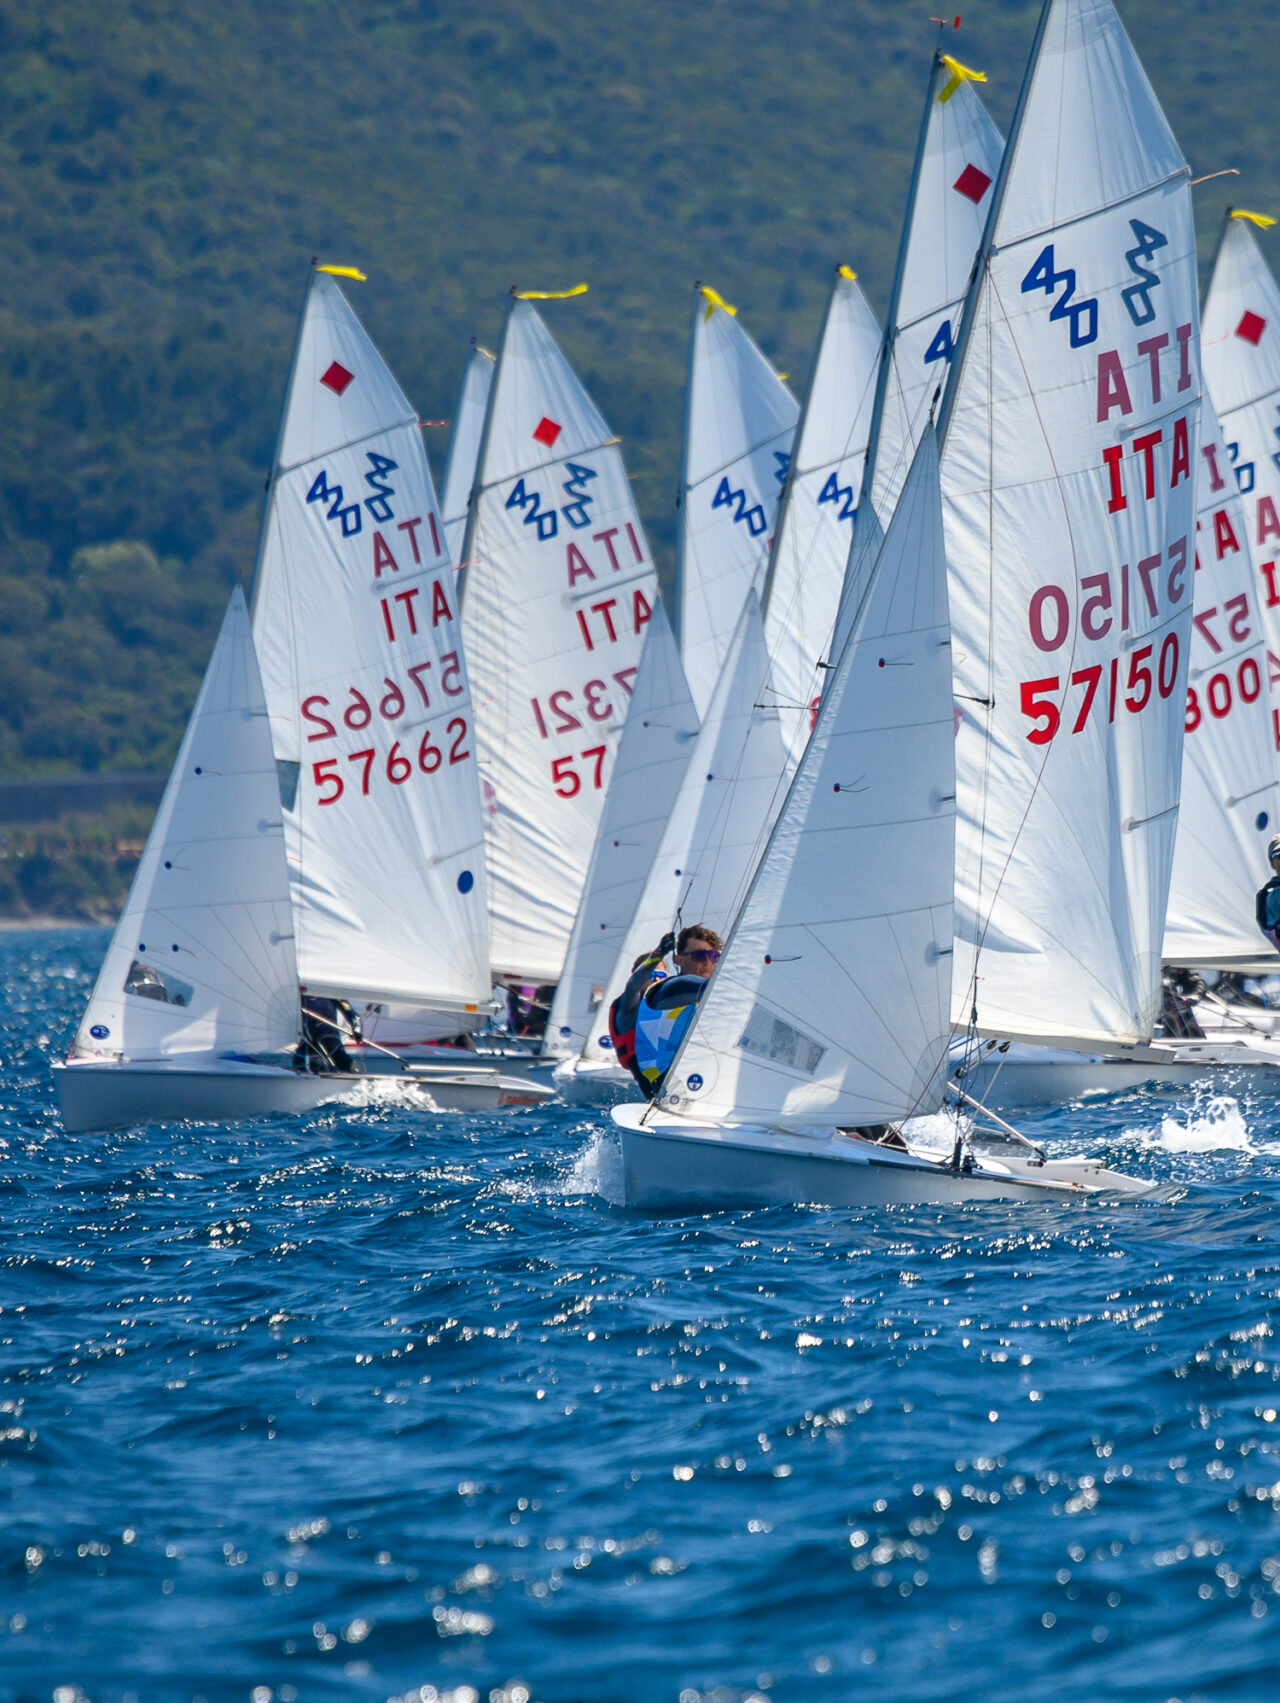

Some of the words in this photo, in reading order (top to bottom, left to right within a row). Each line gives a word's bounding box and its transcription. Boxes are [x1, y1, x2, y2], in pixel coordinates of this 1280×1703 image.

[1021, 244, 1099, 349] 420
[1103, 416, 1190, 514] ITA
[306, 470, 363, 538] 420
[505, 478, 559, 542] 420
[711, 476, 769, 537] 420
[380, 580, 453, 643] ITA
[576, 589, 652, 651] ITA
[1020, 630, 1180, 746] 57150
[312, 717, 470, 805] 57662
